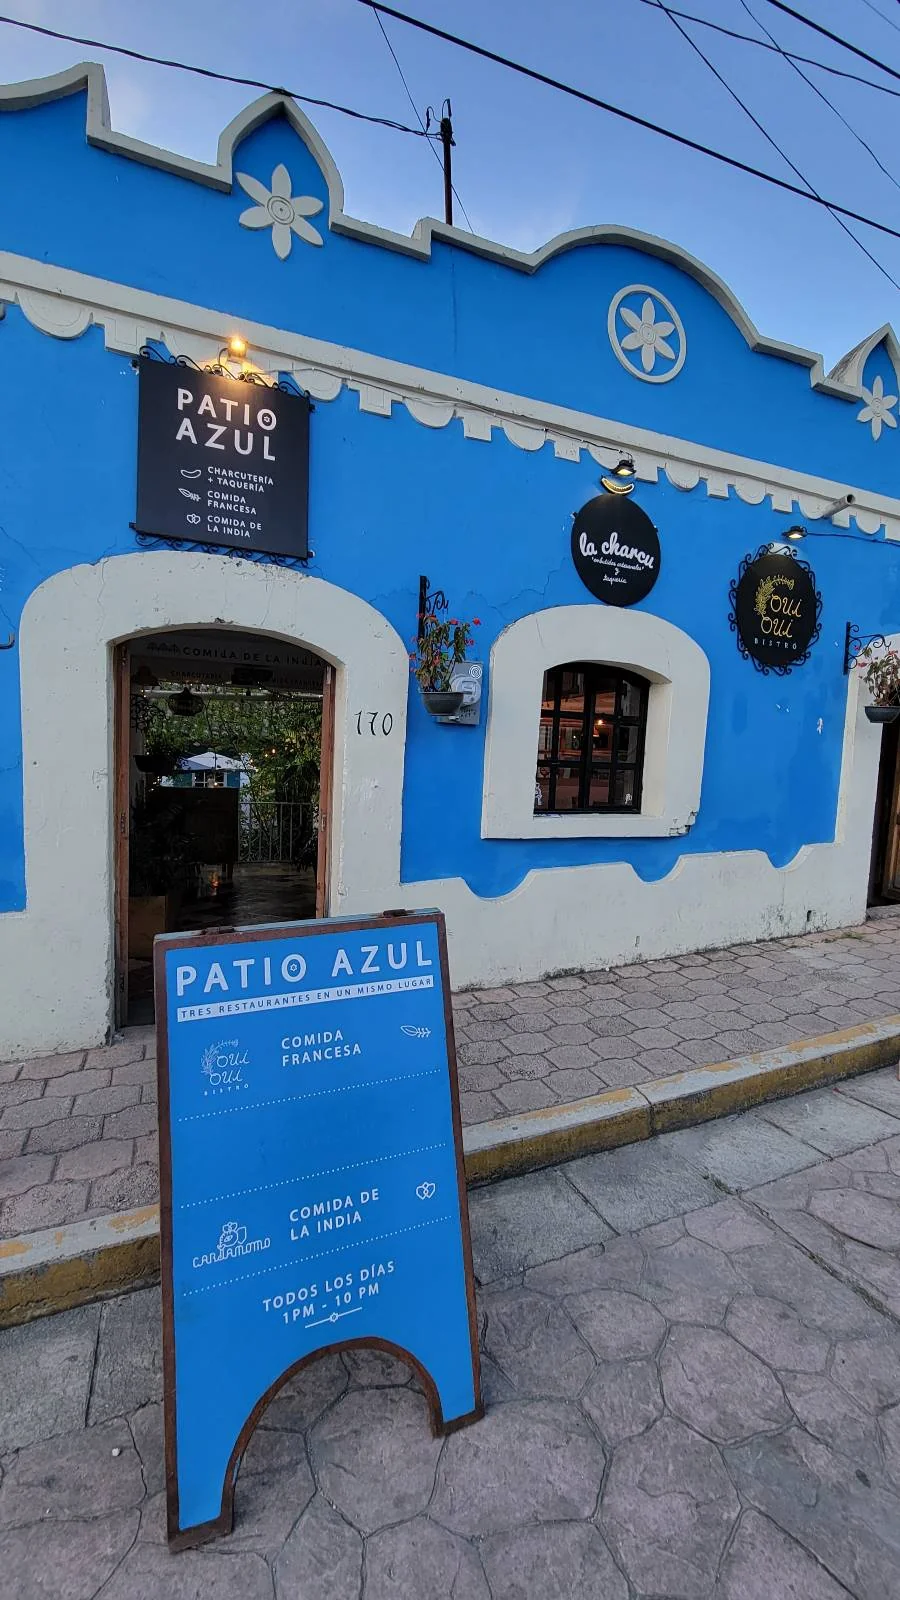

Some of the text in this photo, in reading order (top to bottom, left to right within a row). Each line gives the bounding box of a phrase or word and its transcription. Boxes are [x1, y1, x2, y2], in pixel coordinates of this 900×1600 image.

[177, 387, 277, 431] PATIO
[175, 417, 276, 461] AZUL
[207, 466, 274, 486] CHARCUTERÍA
[217, 477, 265, 493] TAQUERÍA
[207, 490, 246, 504] COMIDA
[207, 500, 257, 515] FRANCESA
[207, 515, 262, 531] COMIDA DE
[207, 524, 251, 538] LA INDIA
[579, 531, 655, 569] la charcu
[353, 710, 393, 736] 170
[176, 940, 433, 997] PATIO AZUL
[182, 978, 432, 1019] TRES RESTAURANTES EN UN MISMO LUGAR
[281, 1029, 344, 1050] COMIDA
[282, 1043, 362, 1067] FRANCESA
[289, 1188, 380, 1222] COMIDA DE
[290, 1210, 362, 1241] LA INDIA
[262, 1260, 395, 1313] TODOS LOS DÍAS
[282, 1304, 315, 1324] 1PM
[335, 1291, 352, 1308] 10
[358, 1282, 380, 1299] PM
